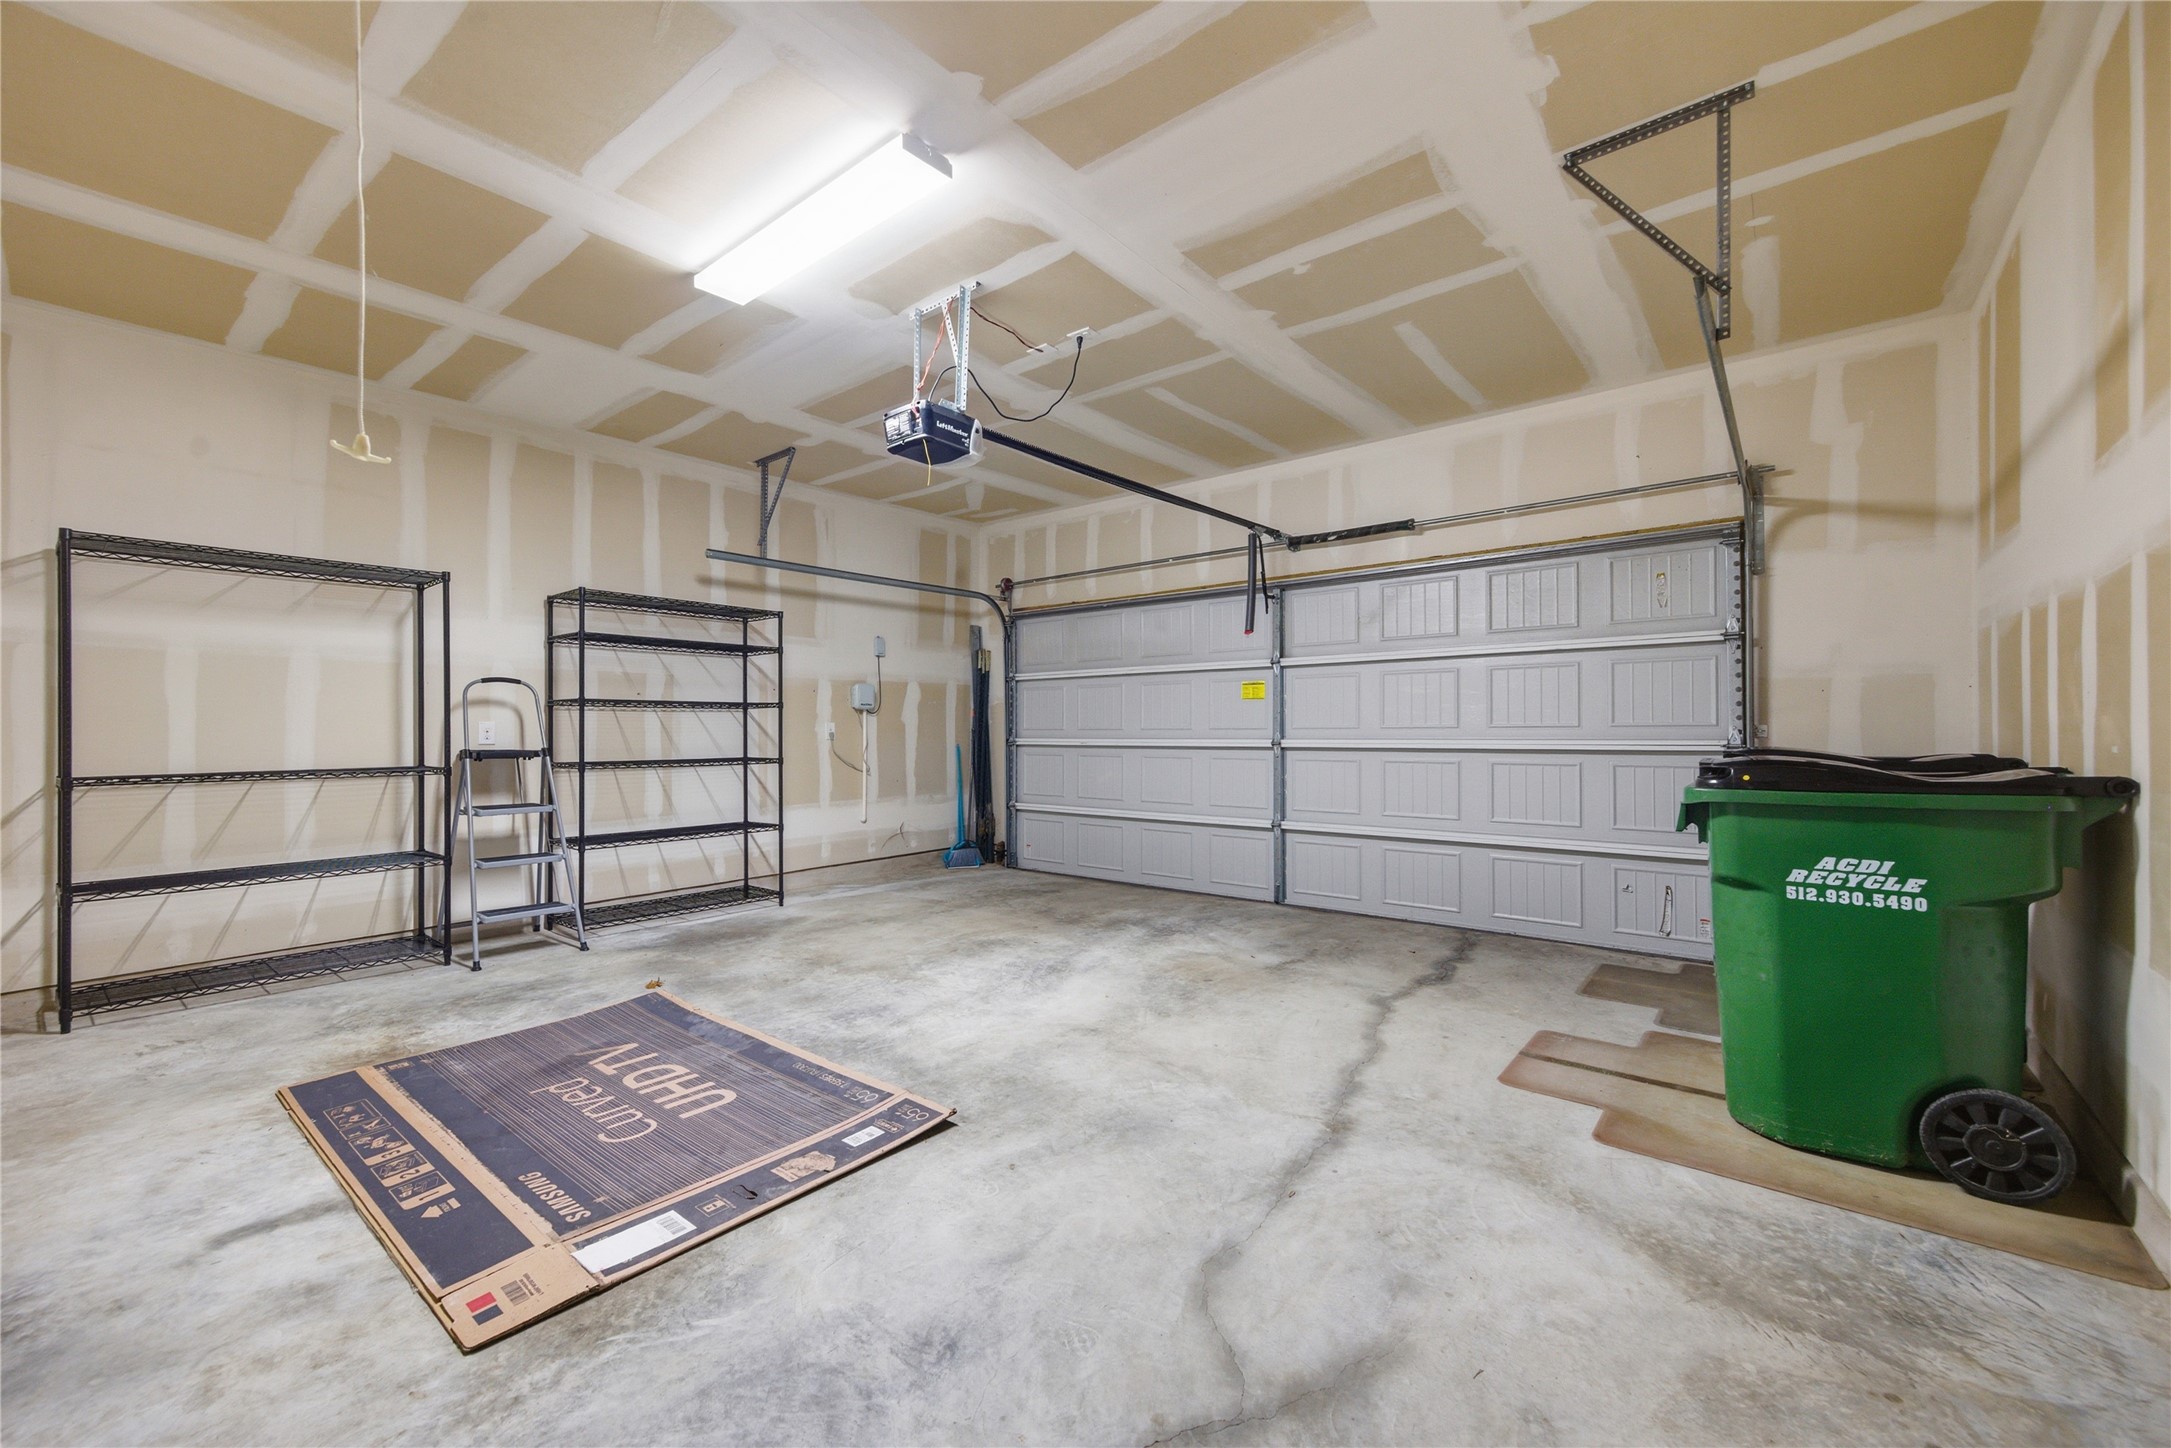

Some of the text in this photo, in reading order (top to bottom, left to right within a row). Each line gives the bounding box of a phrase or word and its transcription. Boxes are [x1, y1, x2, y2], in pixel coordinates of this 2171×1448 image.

[1814, 856, 1895, 875] ACDI
[1785, 869, 1928, 893] RECYCLE
[1785, 885, 1928, 912] 512.930.5490
[530, 1077, 657, 1143] Curved
[399, 1169, 421, 1179] 2
[518, 1171, 591, 1223] SAMSUNG
